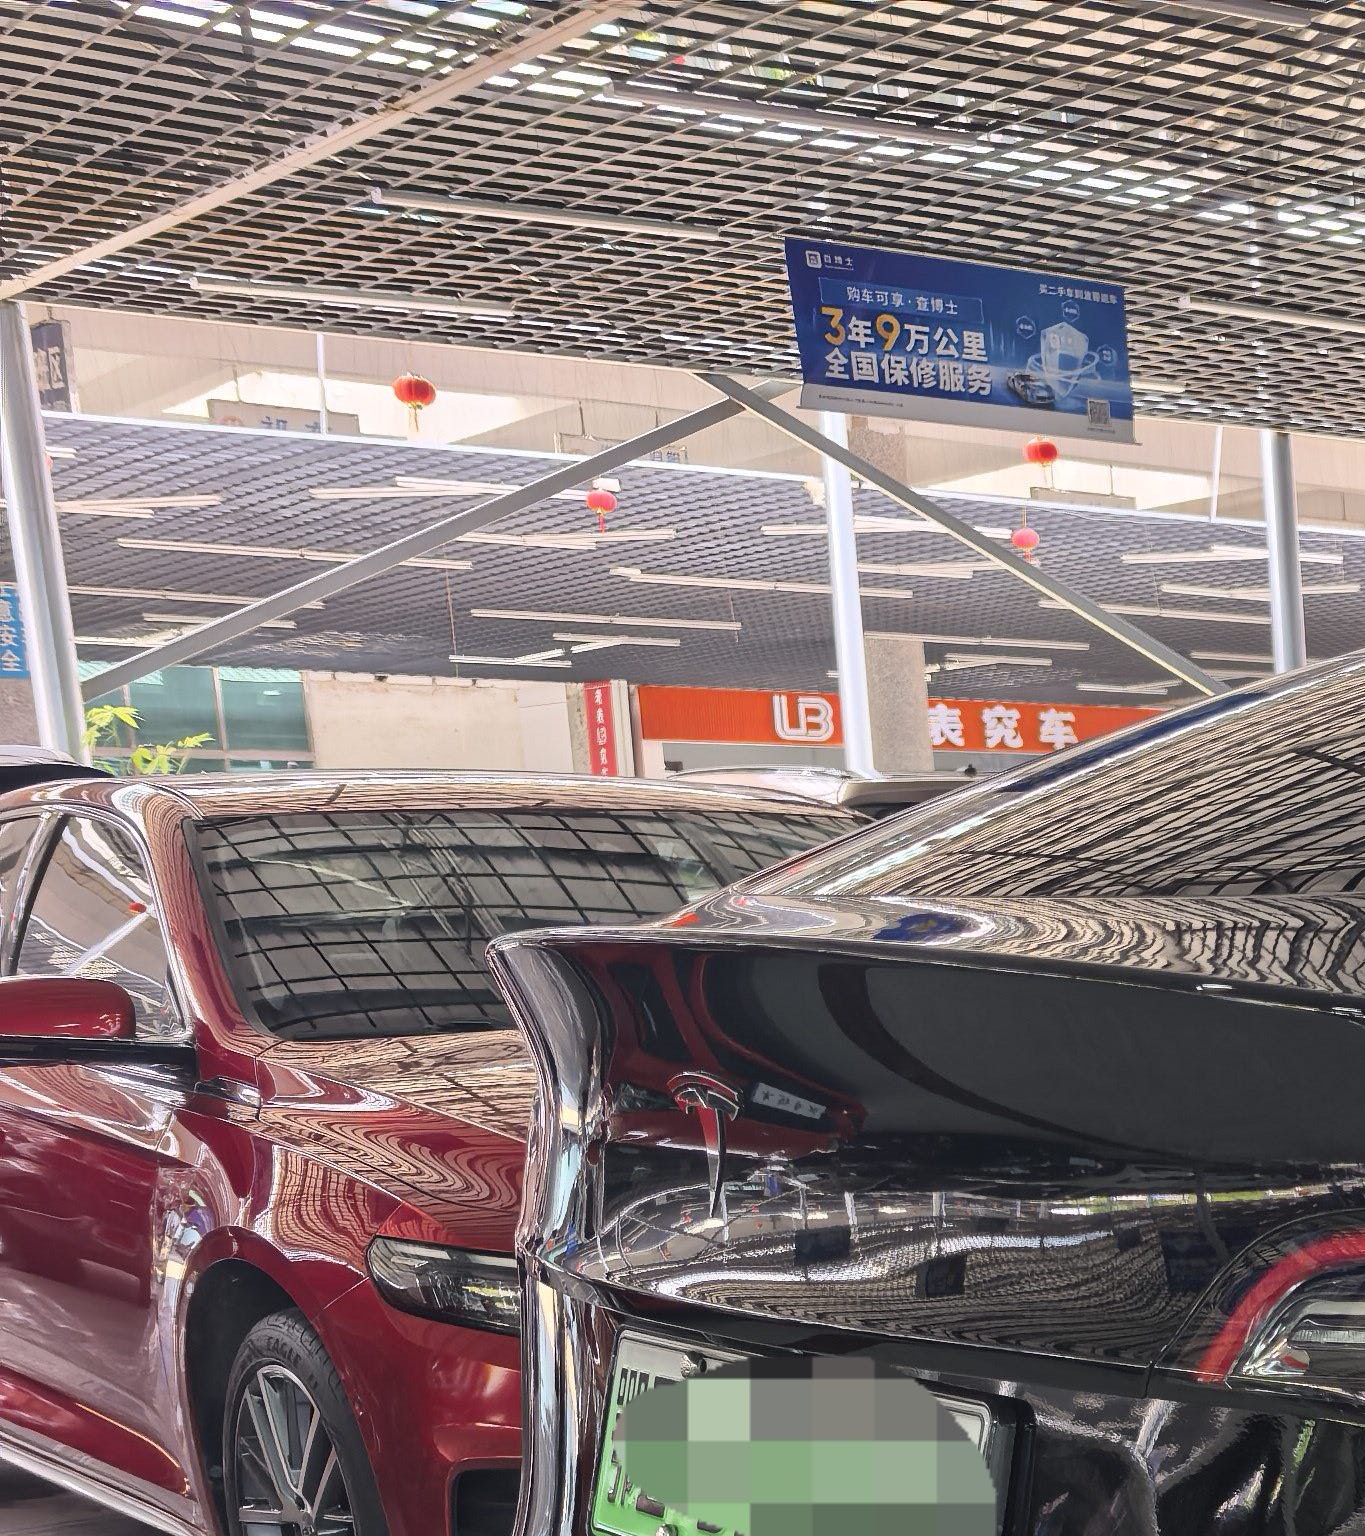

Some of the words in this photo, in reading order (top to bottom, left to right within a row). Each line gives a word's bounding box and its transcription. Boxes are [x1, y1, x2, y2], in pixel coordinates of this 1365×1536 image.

[820, 306, 989, 363] 3年9万公里
[824, 347, 993, 396] 全国保修服务
